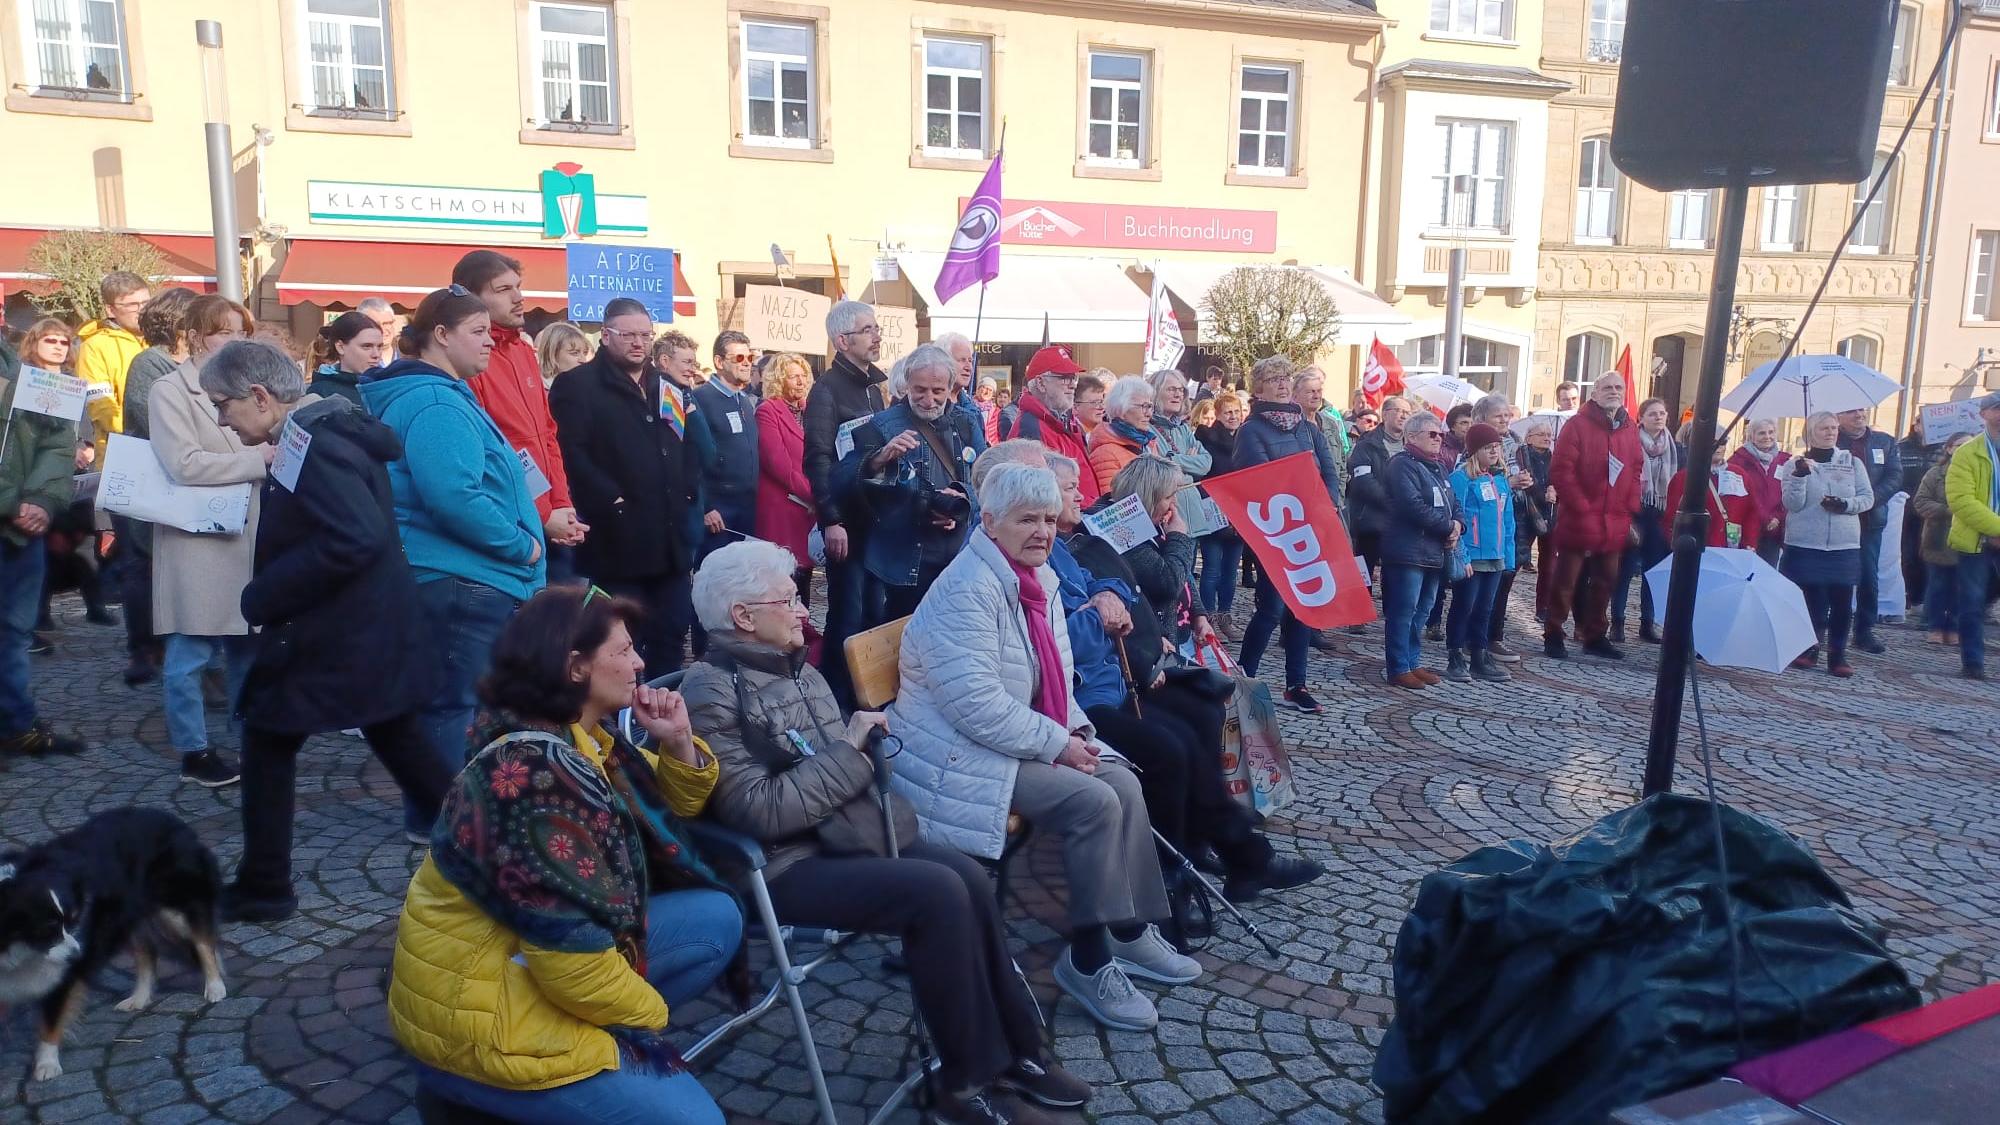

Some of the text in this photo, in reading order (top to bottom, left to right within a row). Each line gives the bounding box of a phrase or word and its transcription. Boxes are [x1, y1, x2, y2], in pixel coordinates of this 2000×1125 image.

[328, 193, 525, 214] KLATSCHMOHN
[1124, 215, 1254, 245] Buchhandlung
[569, 274, 663, 293] ALTERNATIVE
[761, 295, 809, 319] NAZIS
[767, 321, 802, 342] RAUS
[1247, 493, 1337, 607] SPD
